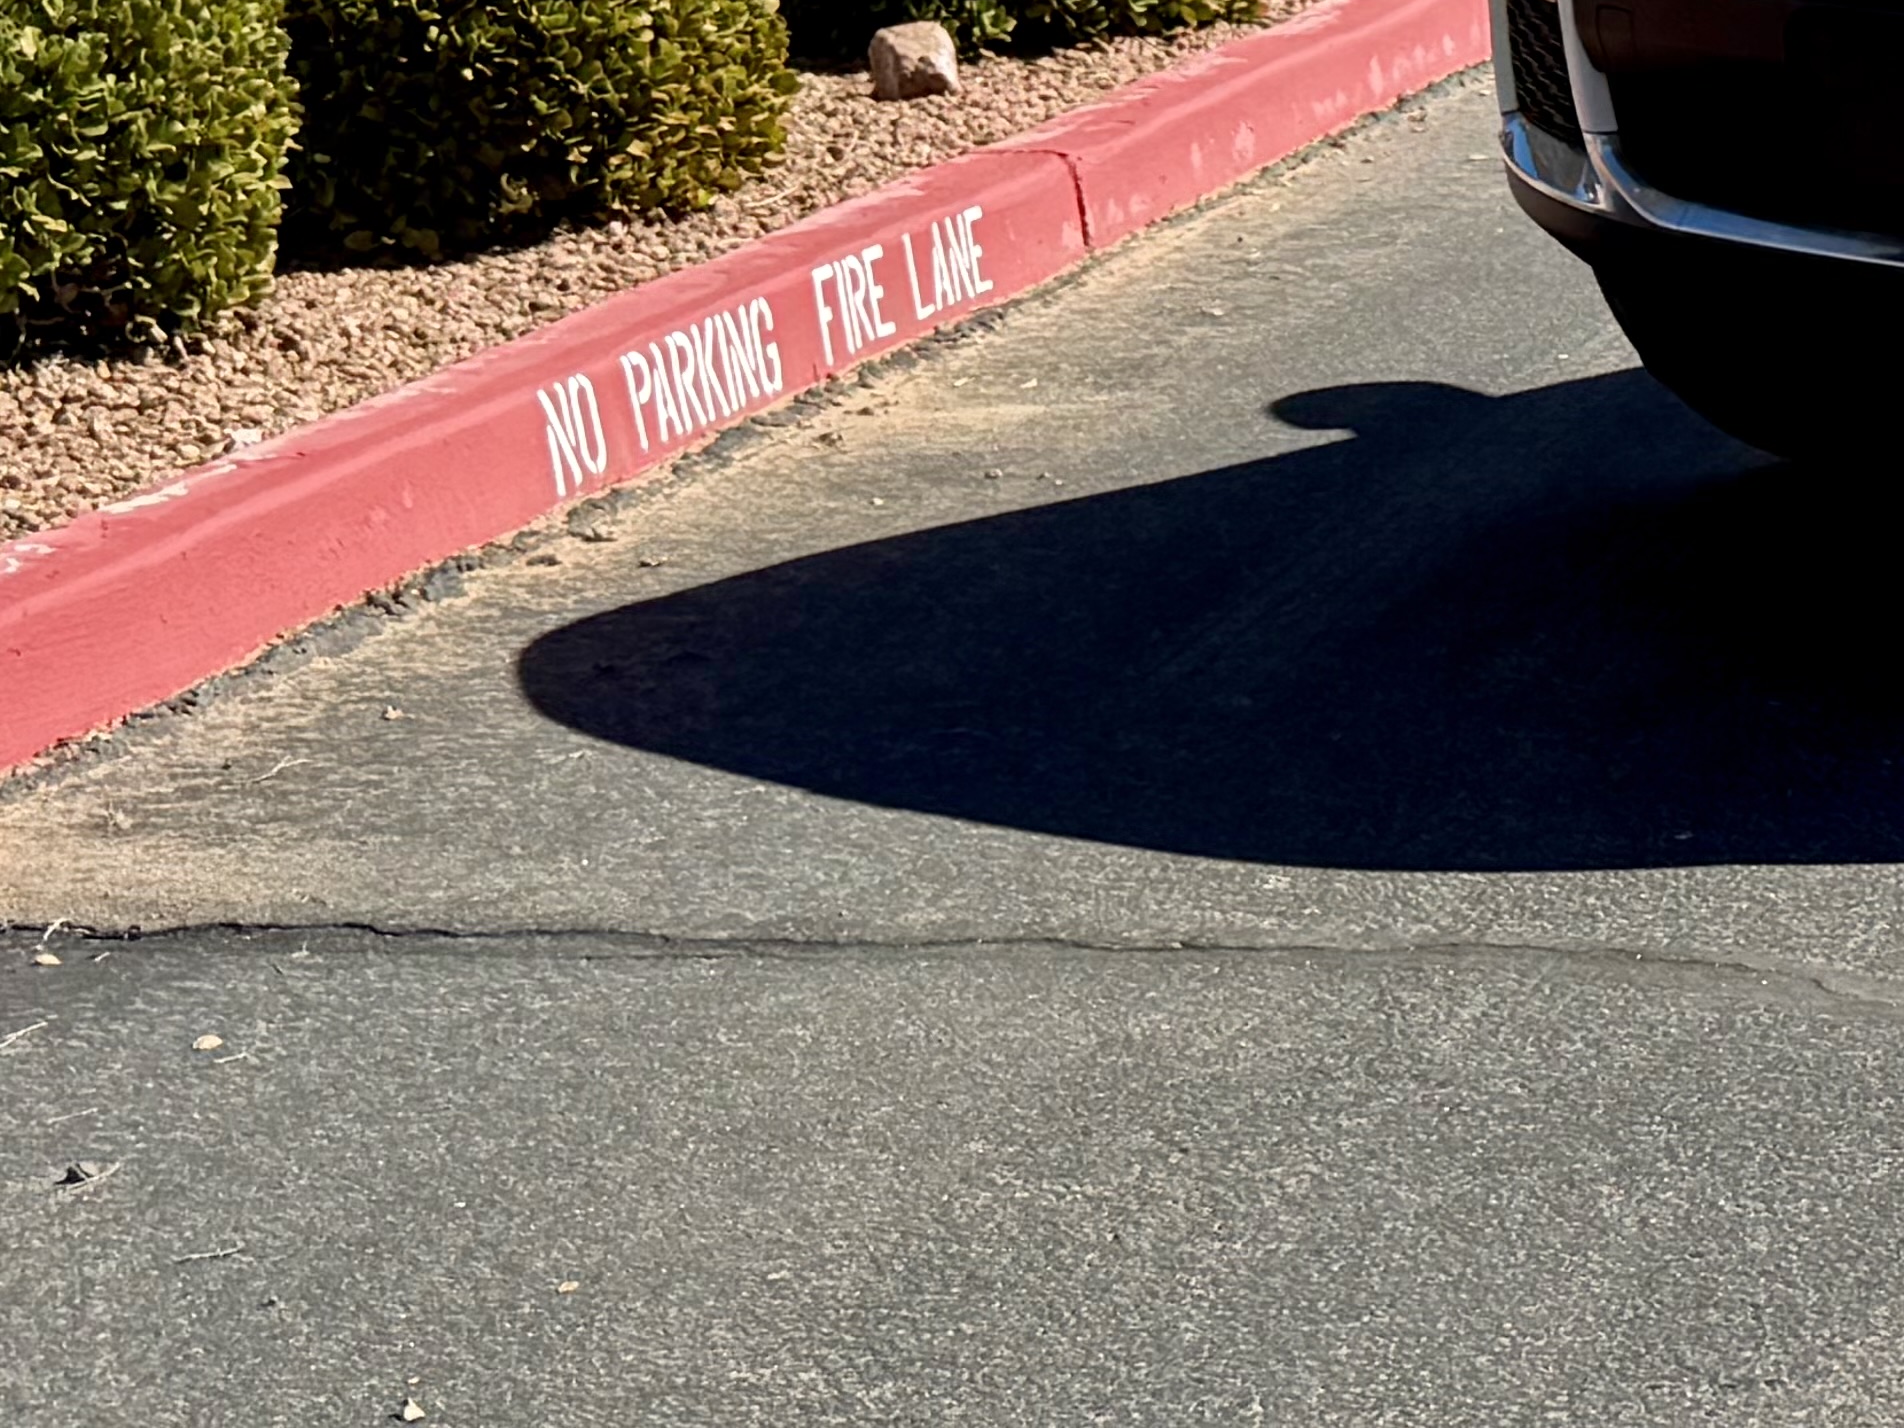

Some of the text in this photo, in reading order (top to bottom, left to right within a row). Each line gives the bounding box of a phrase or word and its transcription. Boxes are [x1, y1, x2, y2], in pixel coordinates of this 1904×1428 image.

[536, 206, 994, 496] NO PARKING FIRE LANE
